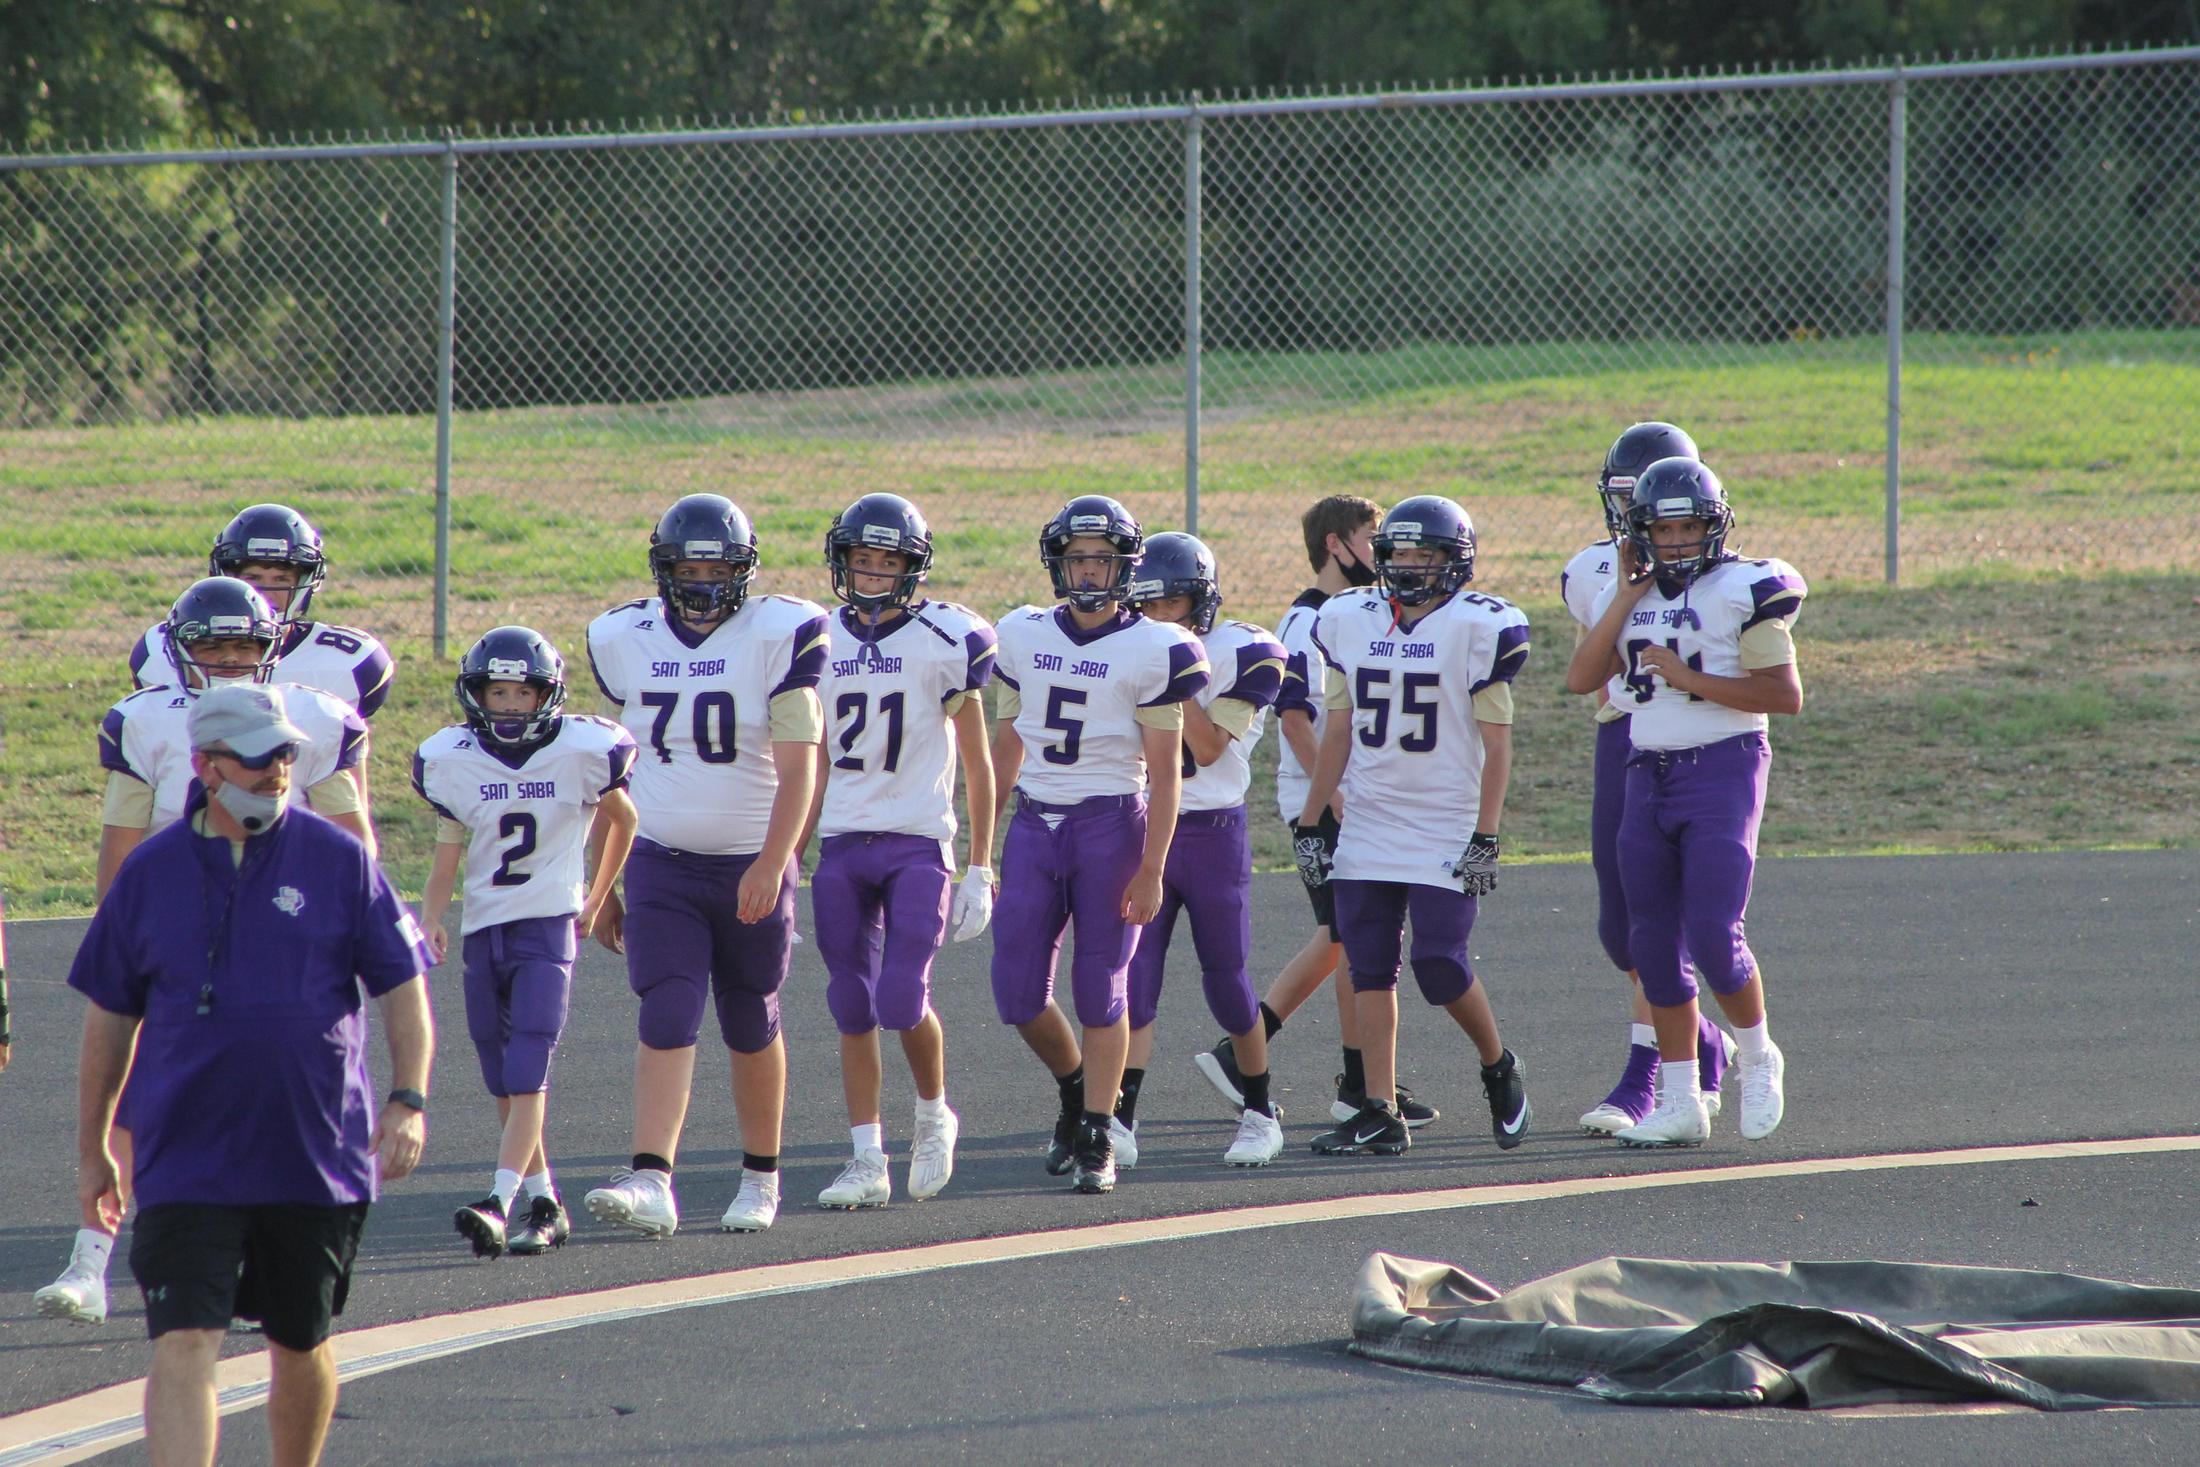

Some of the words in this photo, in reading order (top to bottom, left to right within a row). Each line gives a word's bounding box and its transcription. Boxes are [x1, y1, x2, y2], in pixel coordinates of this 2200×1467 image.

[1632, 611, 1656, 626] SAN
[1368, 641, 1395, 657] SAN
[1401, 643, 1434, 658] SABA
[651, 661, 680, 677] SAN
[688, 659, 726, 677] SABA
[832, 658, 860, 678] SAN
[868, 657, 902, 674] SABA
[1034, 653, 1063, 671] SAN
[1356, 667, 1440, 752] 55
[641, 691, 736, 764] 70
[834, 690, 905, 773] 21
[1043, 685, 1088, 765] 5
[480, 783, 508, 801] SAN
[518, 781, 555, 799] SABA
[492, 812, 537, 886] 2
